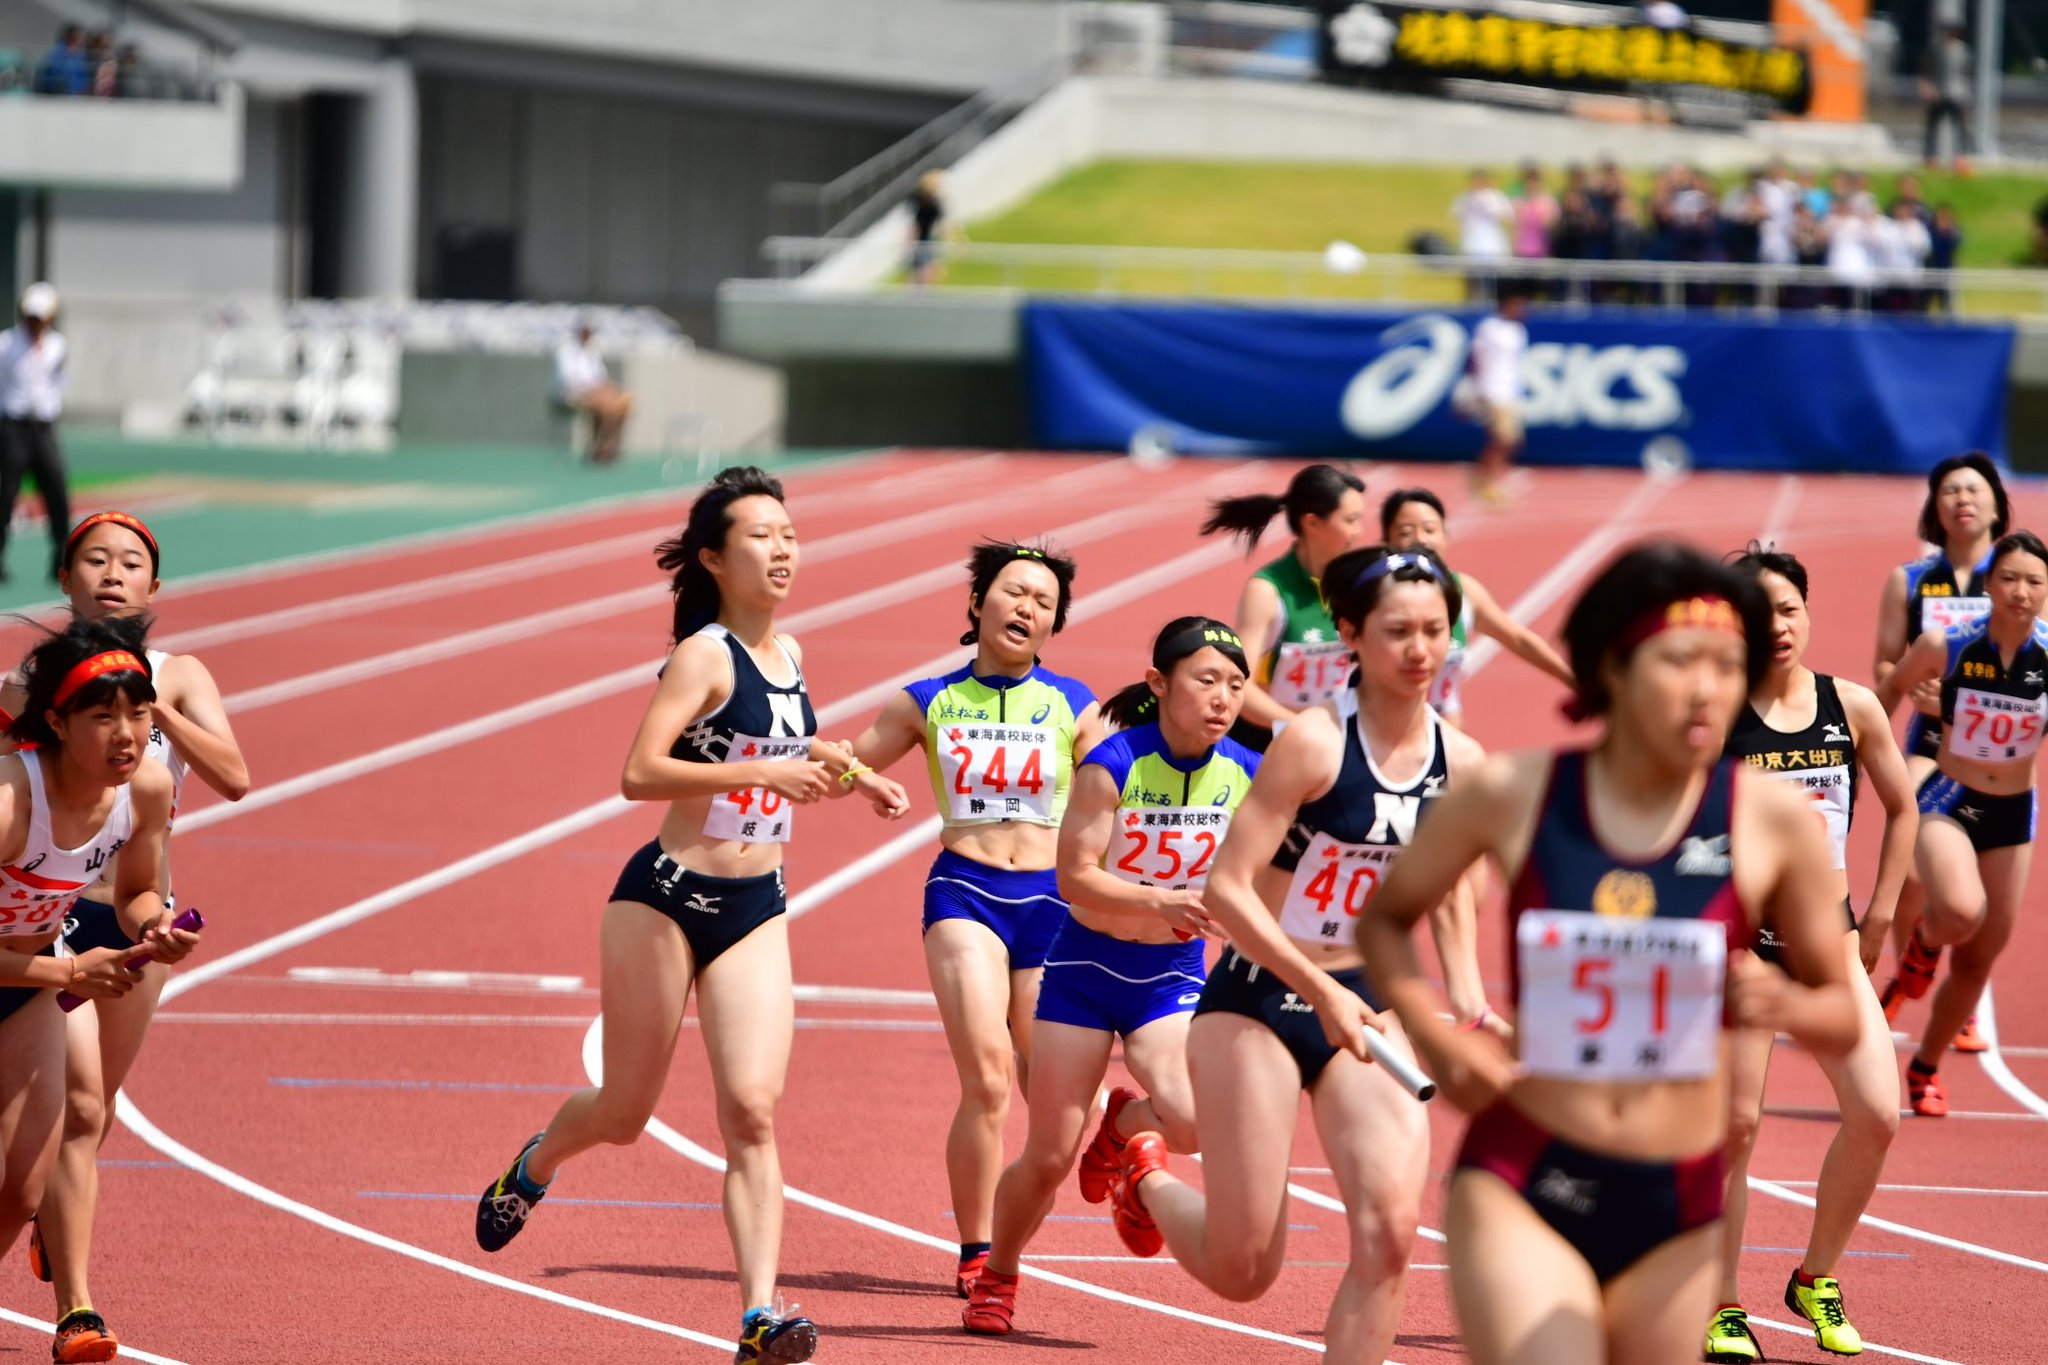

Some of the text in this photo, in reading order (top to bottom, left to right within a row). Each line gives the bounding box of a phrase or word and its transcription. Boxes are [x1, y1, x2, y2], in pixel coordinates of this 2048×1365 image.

[766, 693, 806, 738] N
[940, 703, 989, 721] 浜松西
[1962, 707, 2042, 746] 705
[967, 728, 1047, 744] 東海高校総体
[949, 745, 1044, 796] 244
[725, 785, 795, 817] 40
[969, 797, 1020, 814] 静岡
[1143, 812, 1222, 827] 東海高校総体
[1364, 791, 1422, 847] N
[1116, 830, 1217, 881] 252
[1572, 955, 1672, 1038] 51
